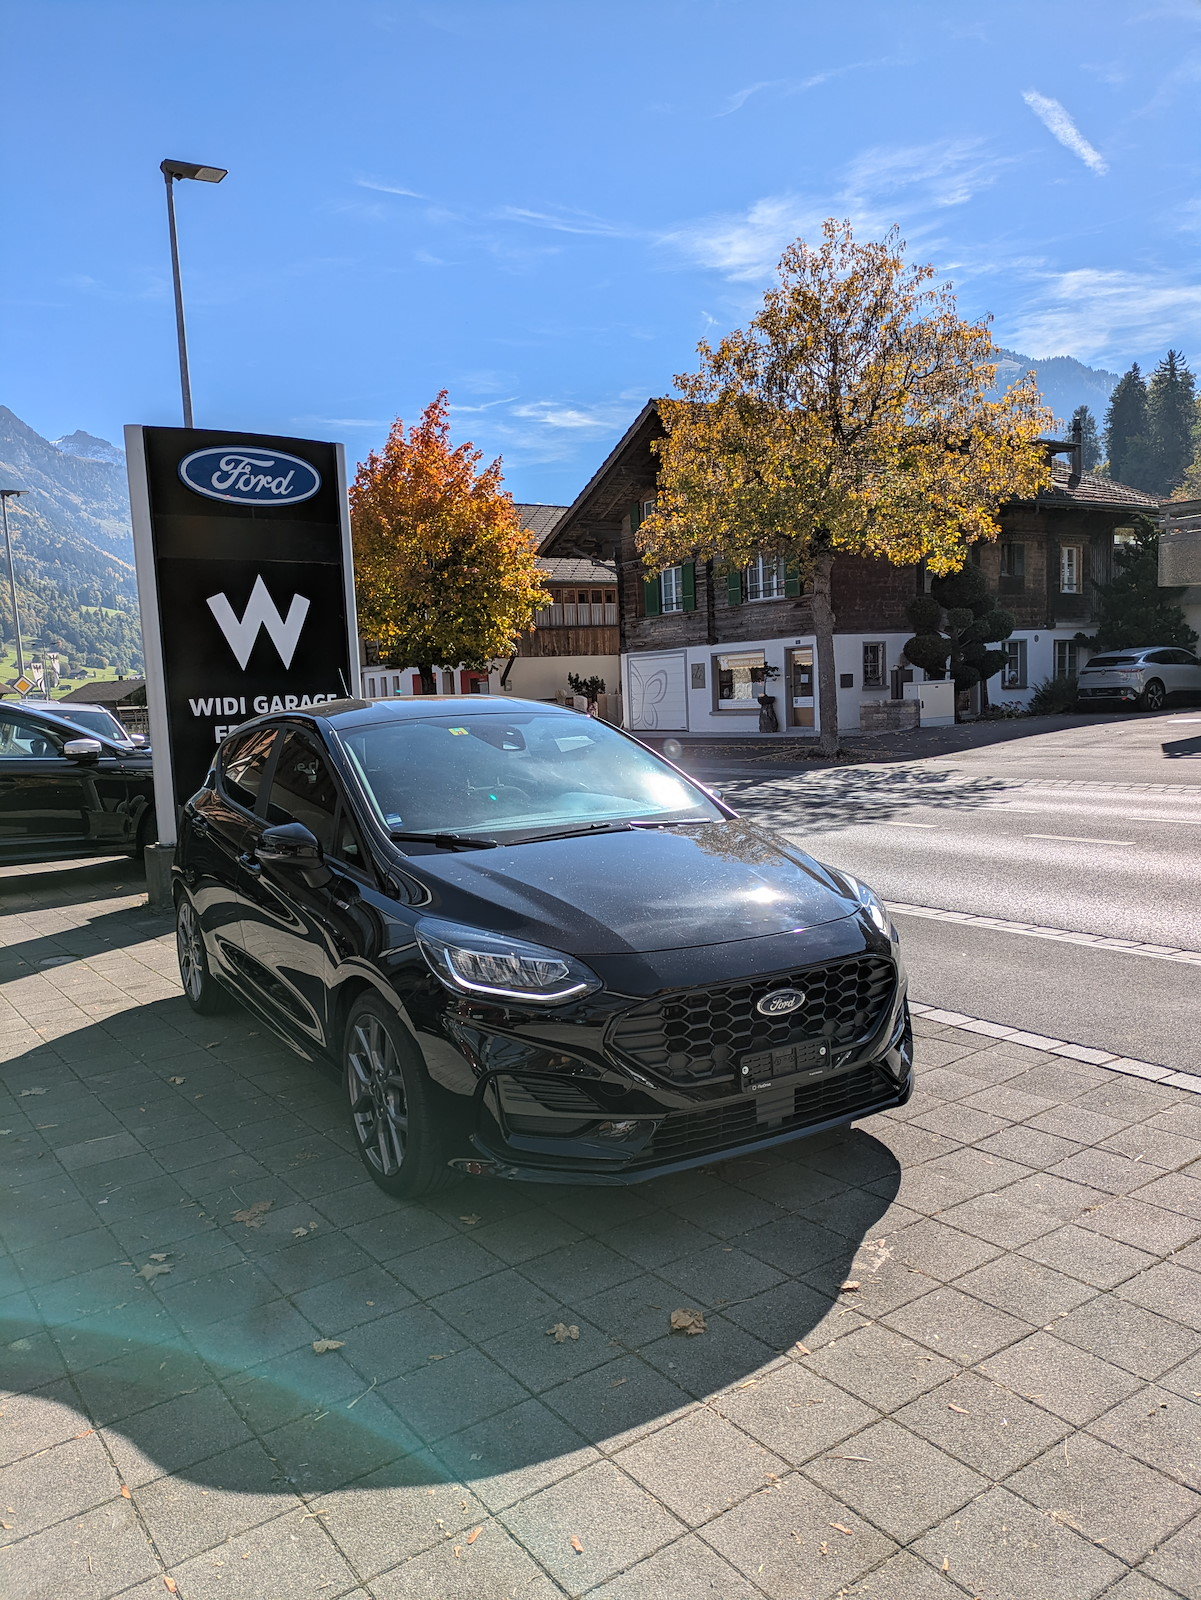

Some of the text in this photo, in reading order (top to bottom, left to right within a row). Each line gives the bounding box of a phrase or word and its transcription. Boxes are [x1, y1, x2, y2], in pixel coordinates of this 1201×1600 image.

[211, 455, 295, 495] Ford
[206, 574, 311, 671] W
[188, 696, 246, 717] WIDI
[770, 994, 796, 1011] Ford
